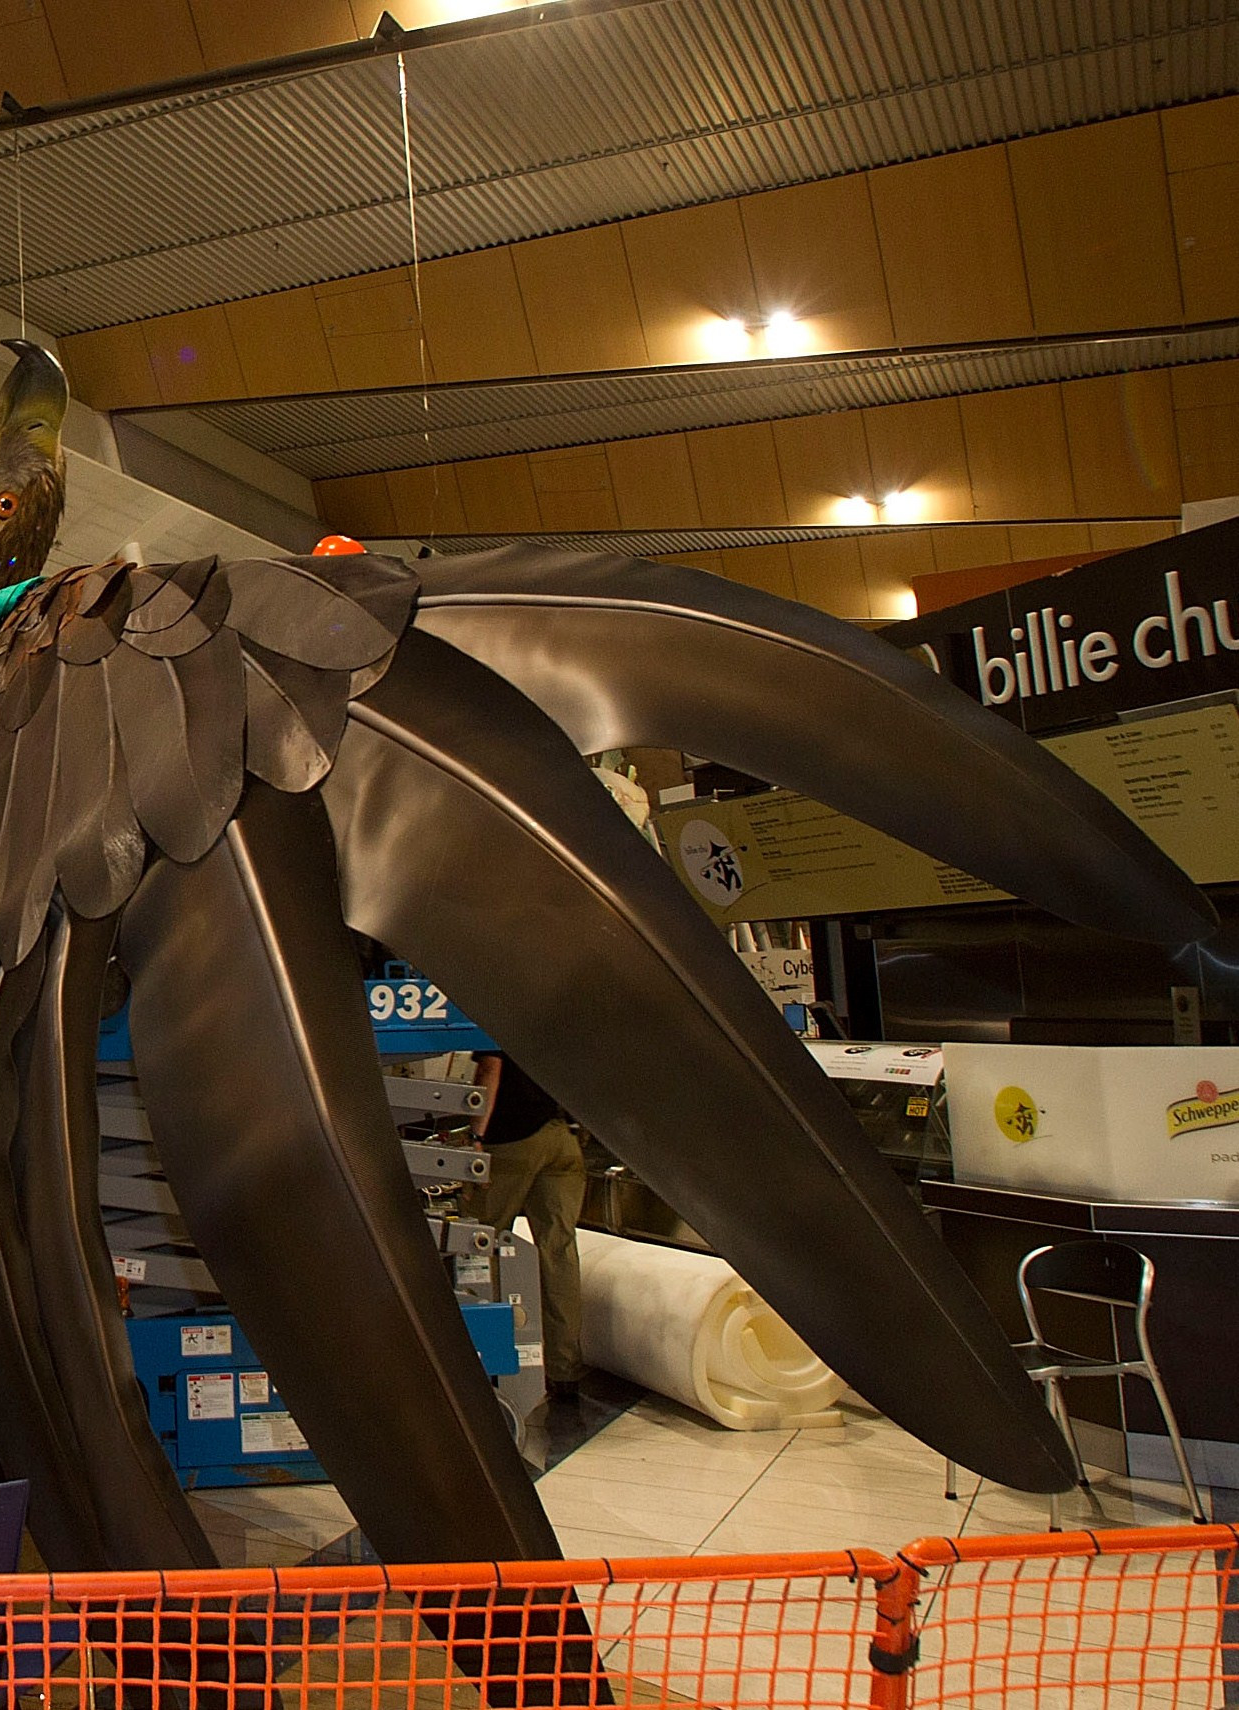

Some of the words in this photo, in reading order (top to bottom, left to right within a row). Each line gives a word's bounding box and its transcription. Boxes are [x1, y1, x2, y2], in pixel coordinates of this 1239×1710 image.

[972, 606, 1119, 706] billie
[369, 984, 448, 1020] 932
[1173, 1100, 1239, 1127] Schweppe
